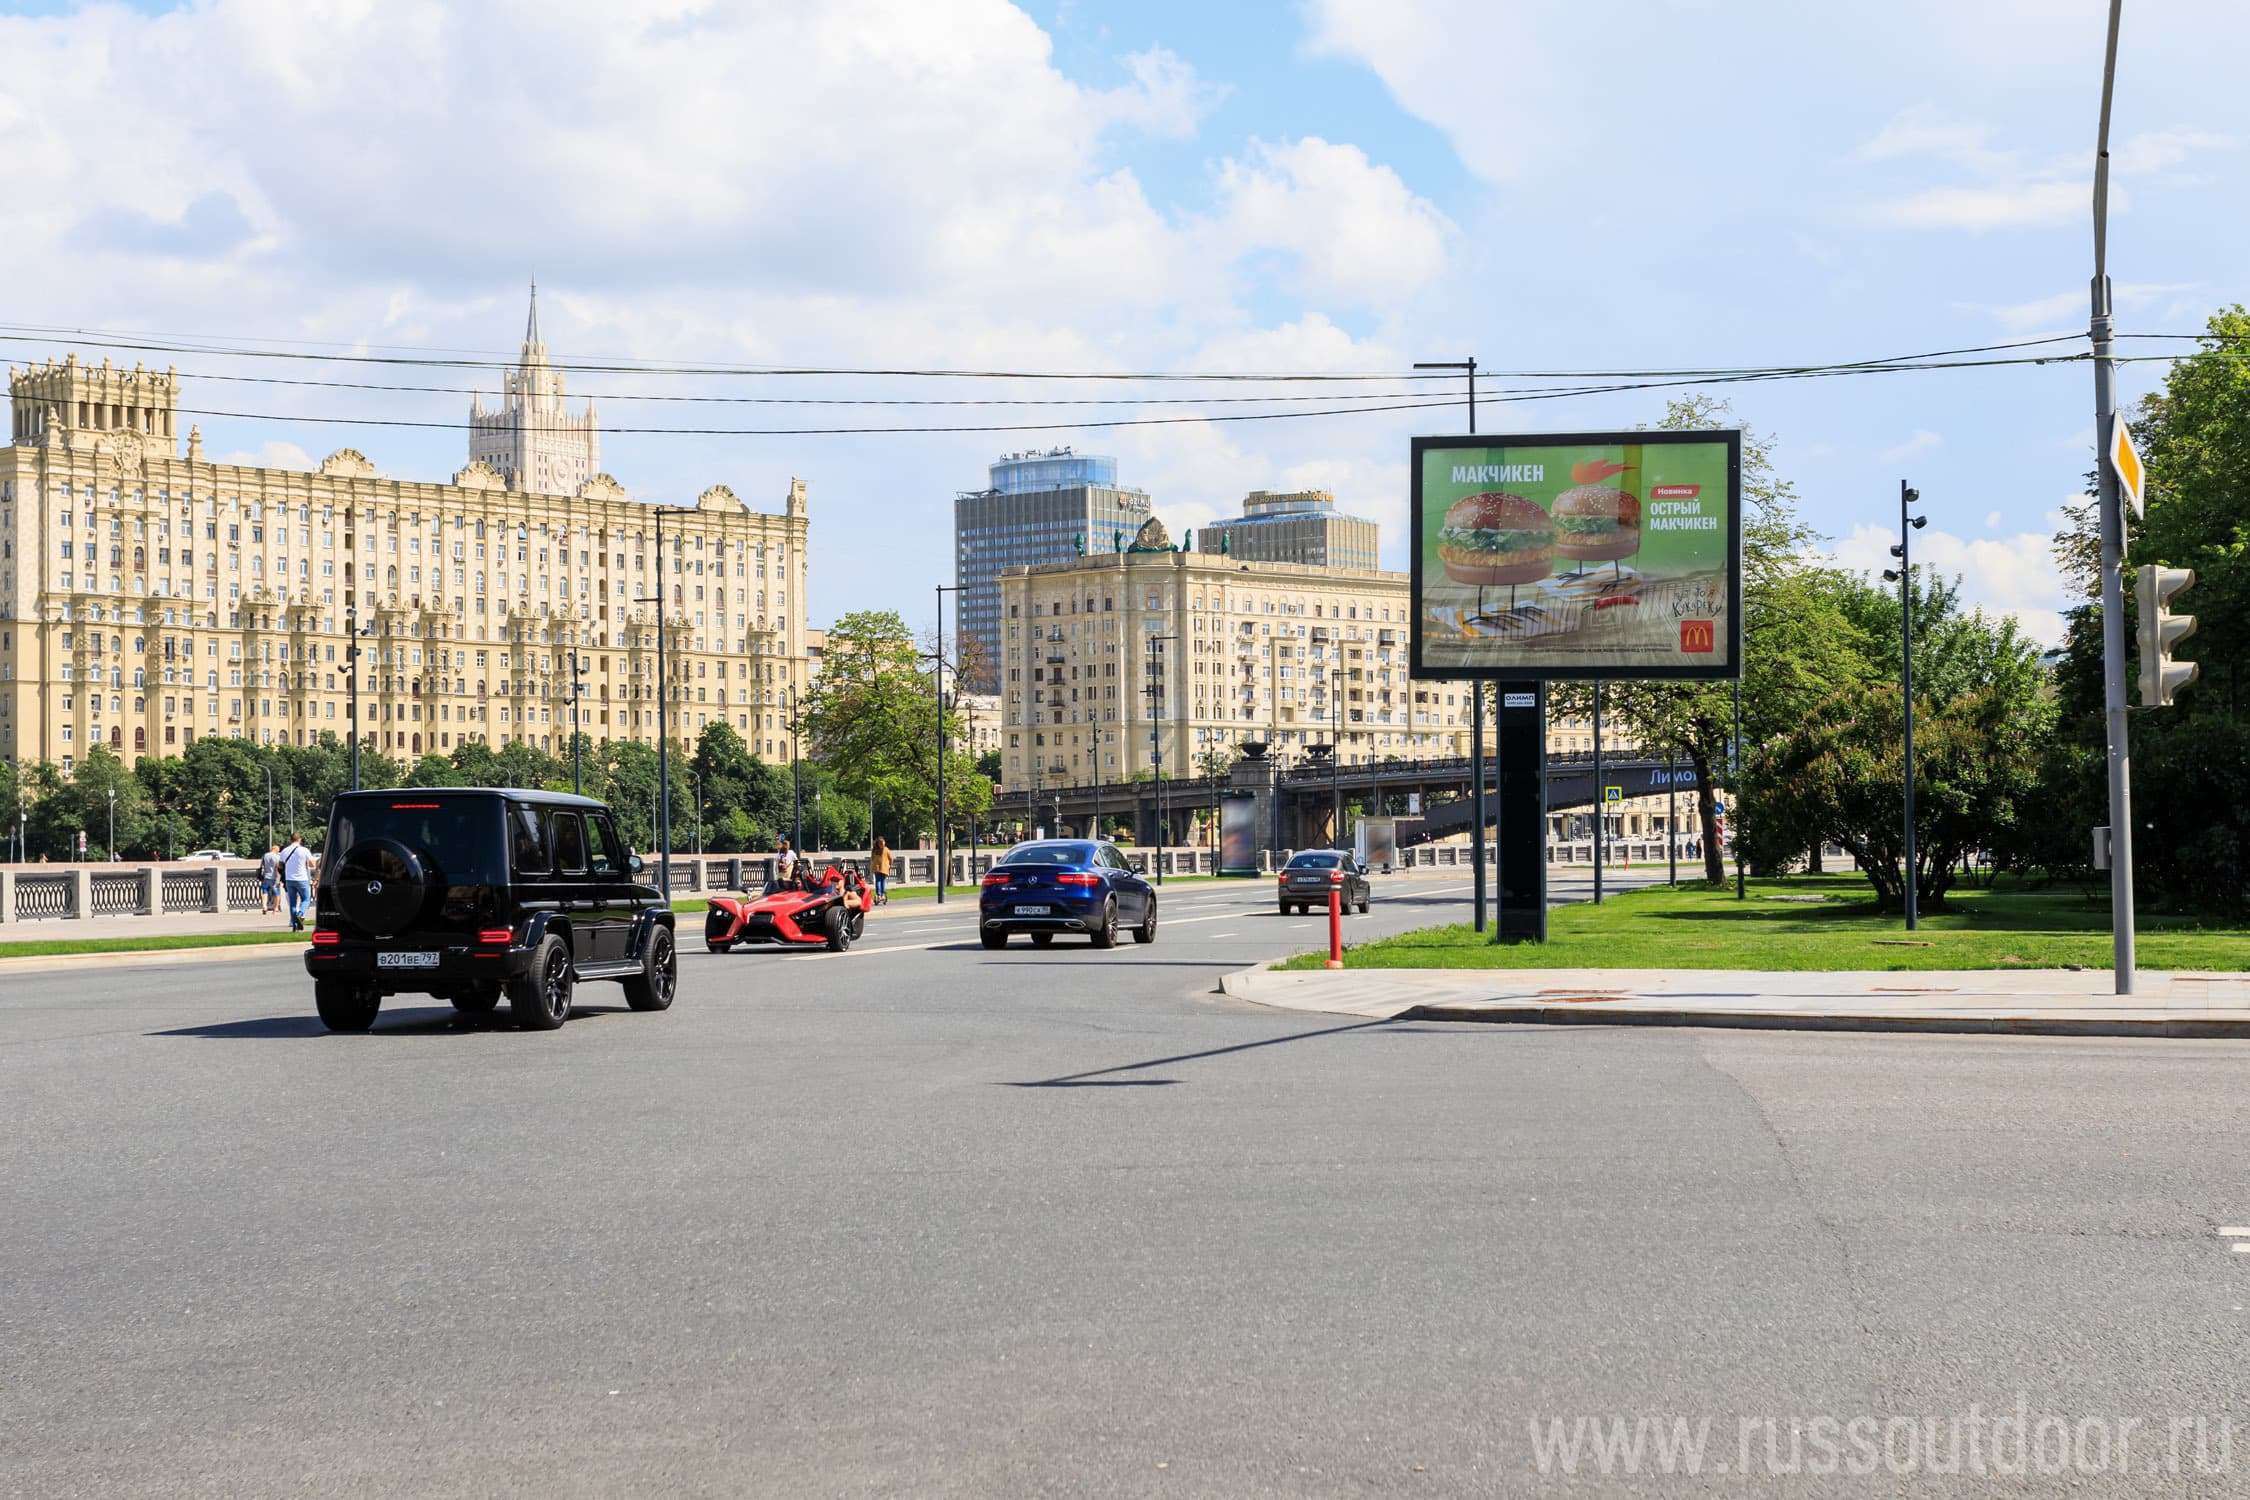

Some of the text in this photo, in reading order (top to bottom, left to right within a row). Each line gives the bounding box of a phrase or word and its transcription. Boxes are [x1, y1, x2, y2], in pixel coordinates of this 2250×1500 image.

[1452, 464, 1544, 483] МАКЧИКЕН
[1650, 497, 1701, 515] ОСТРЫЙ
[1650, 517, 1717, 530] МАКЧИКЕН
